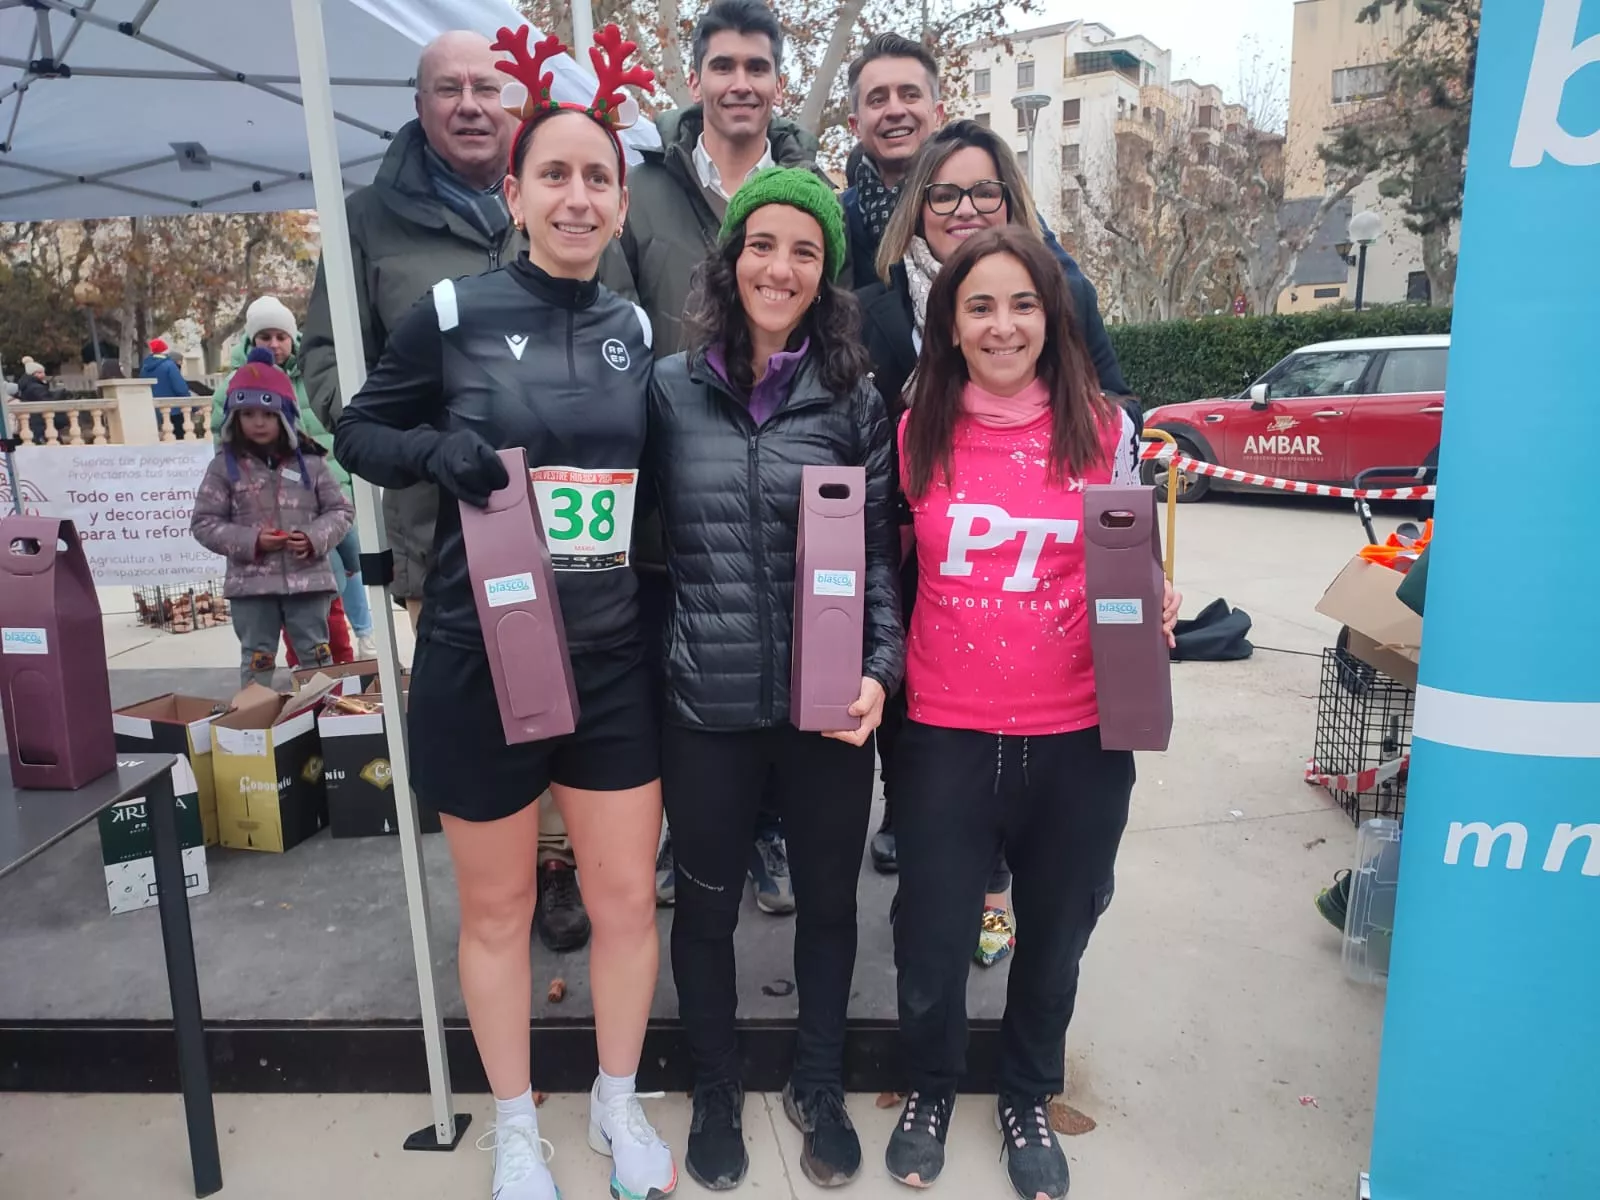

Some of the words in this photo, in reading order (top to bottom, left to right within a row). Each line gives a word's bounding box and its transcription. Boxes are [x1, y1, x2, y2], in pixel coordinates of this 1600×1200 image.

[1243, 435, 1322, 455] AMBAR
[146, 469, 163, 478] tus
[66, 490, 108, 503] Todo
[115, 492, 134, 502] en
[140, 487, 198, 501] cerámi
[89, 513, 99, 526] y
[549, 487, 615, 541] 38
[79, 530, 116, 541] para
[122, 527, 140, 539] tu
[940, 503, 1079, 592] PT
[89, 554, 154, 567] Agricultura
[160, 553, 172, 562] 18
[488, 580, 529, 593] blasco
[817, 574, 852, 586] blasco
[942, 596, 1003, 609] SPORT
[1018, 598, 1070, 610] TEAM
[1098, 603, 1138, 614] blasco
[4, 631, 42, 644] blasco
